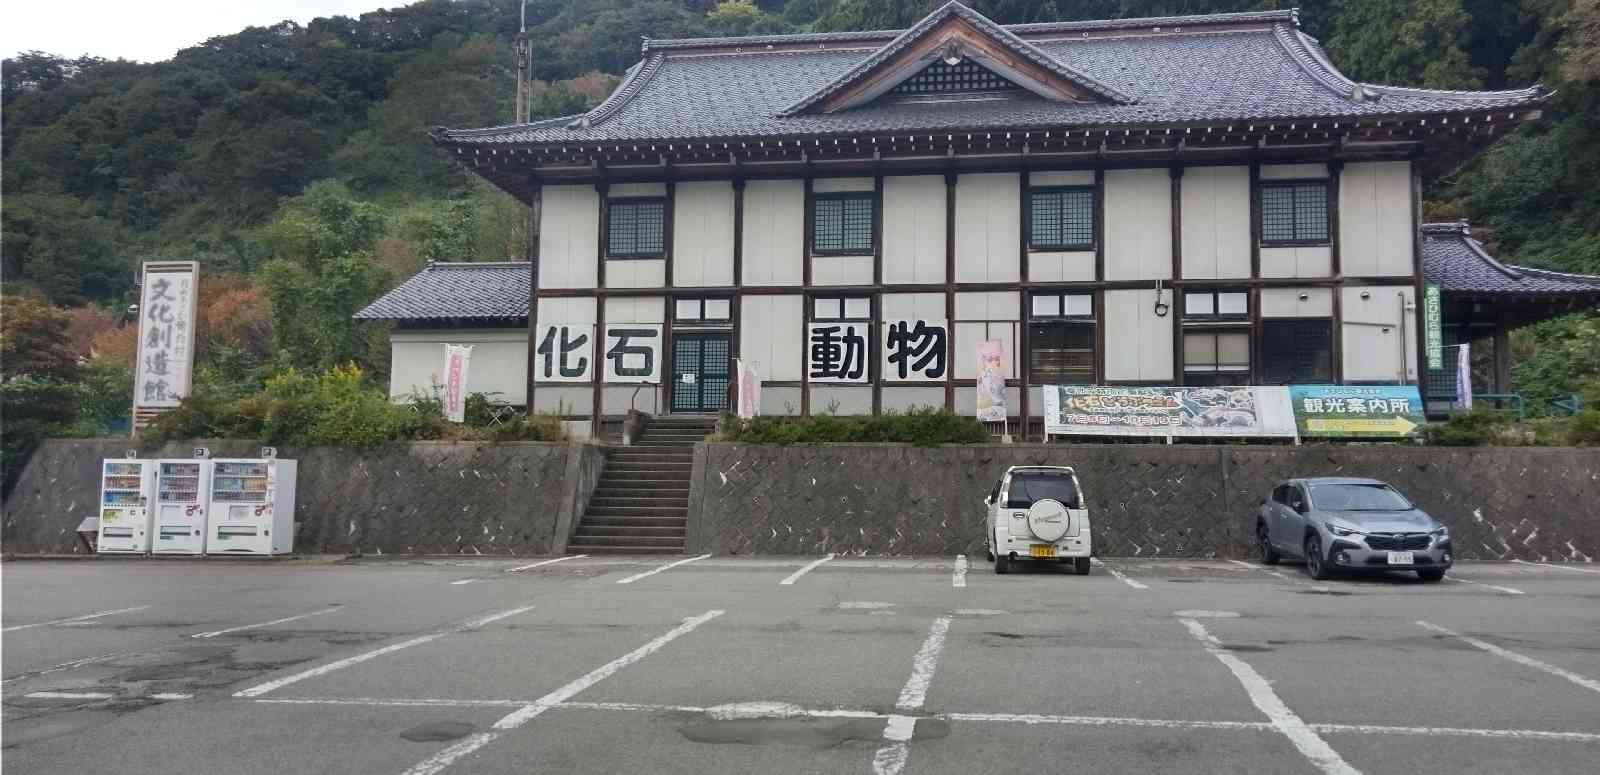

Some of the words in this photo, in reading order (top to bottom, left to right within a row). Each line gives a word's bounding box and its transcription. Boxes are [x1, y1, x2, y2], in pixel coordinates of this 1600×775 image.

[143, 278, 175, 402] 文化創造館
[537, 325, 657, 378] 化石
[810, 320, 947, 379] 動物
[1303, 397, 1410, 414] 観光案内所
